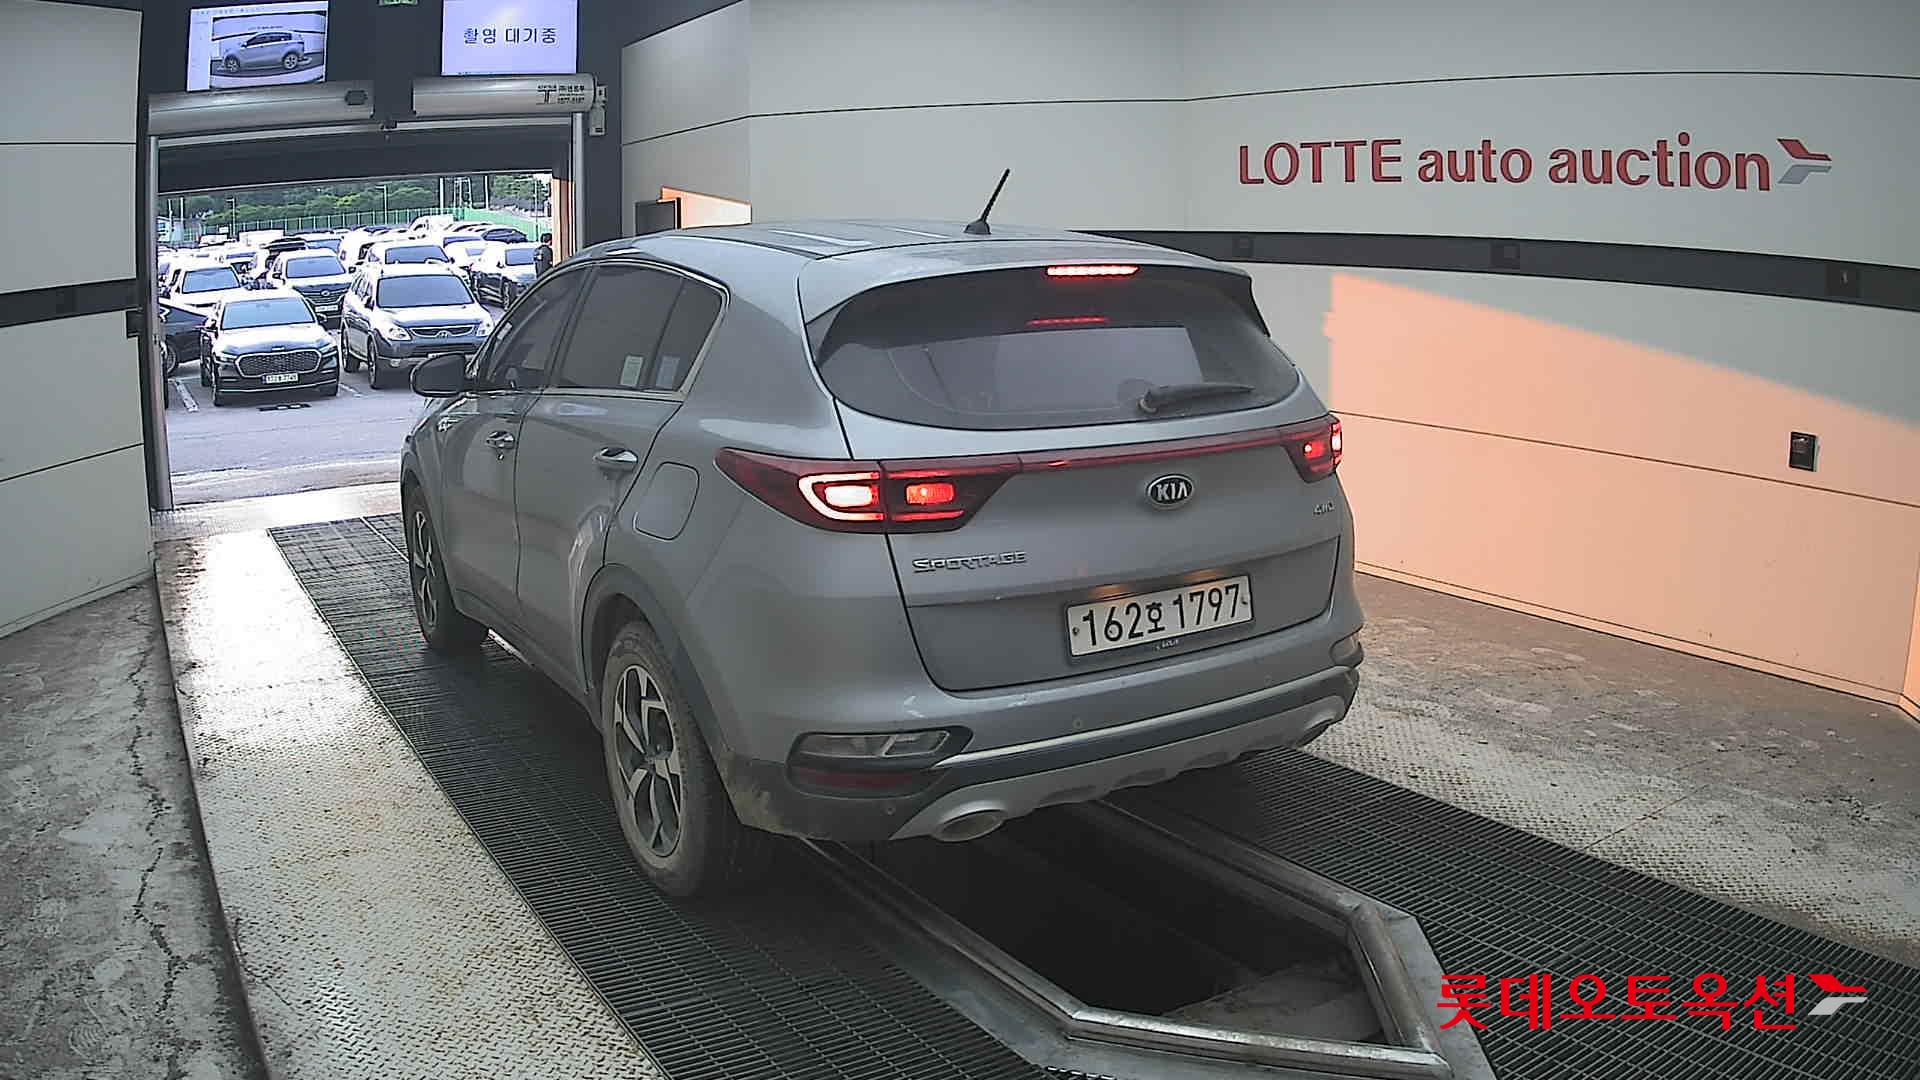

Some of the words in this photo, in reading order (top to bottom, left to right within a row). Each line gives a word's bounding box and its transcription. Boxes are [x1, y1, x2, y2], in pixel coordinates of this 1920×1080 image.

[463, 27, 497, 45] 촬영
[505, 27, 557, 45] 대기중
[1239, 138, 1402, 186] LOTTE
[1417, 138, 1533, 184] auto
[1548, 131, 1771, 192] auction
[1156, 480, 1188, 501] KIA
[911, 550, 1027, 573] SPORTAGE
[1082, 601, 1166, 647] 162호
[1172, 583, 1240, 629] 1797
